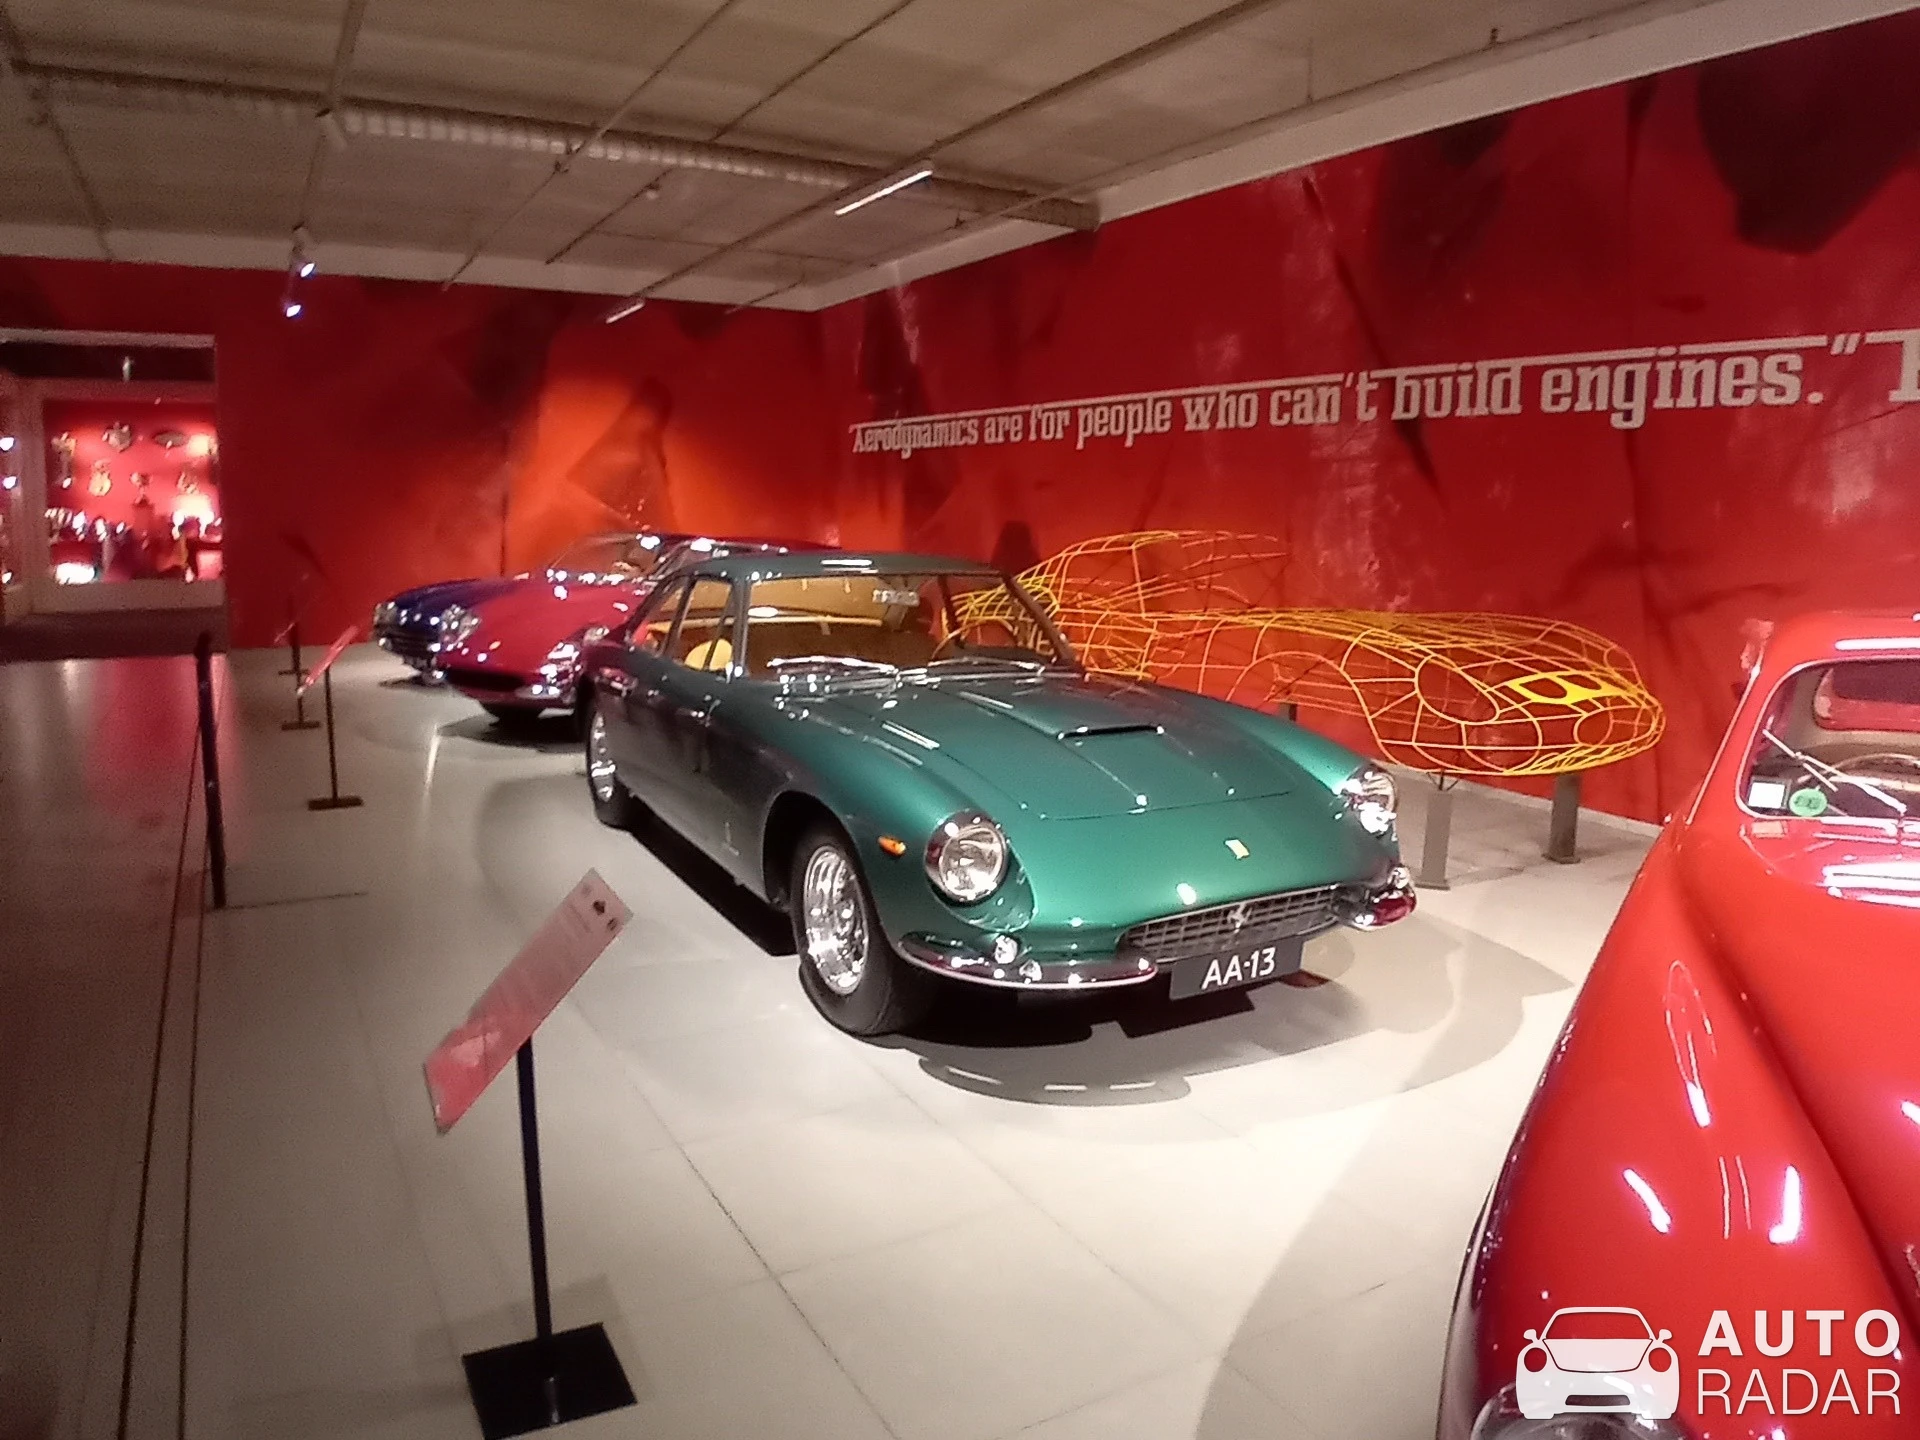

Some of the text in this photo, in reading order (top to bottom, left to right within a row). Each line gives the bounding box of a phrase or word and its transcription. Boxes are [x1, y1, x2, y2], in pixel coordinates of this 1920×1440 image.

[850, 411, 979, 459] Aerodynamics
[984, 413, 1023, 443] are
[1028, 403, 1070, 441] for
[1076, 395, 1173, 450] people
[1182, 387, 1260, 432] who
[1269, 371, 1379, 427] can't
[1390, 359, 1523, 421] build
[1201, 947, 1276, 990] AA-13
